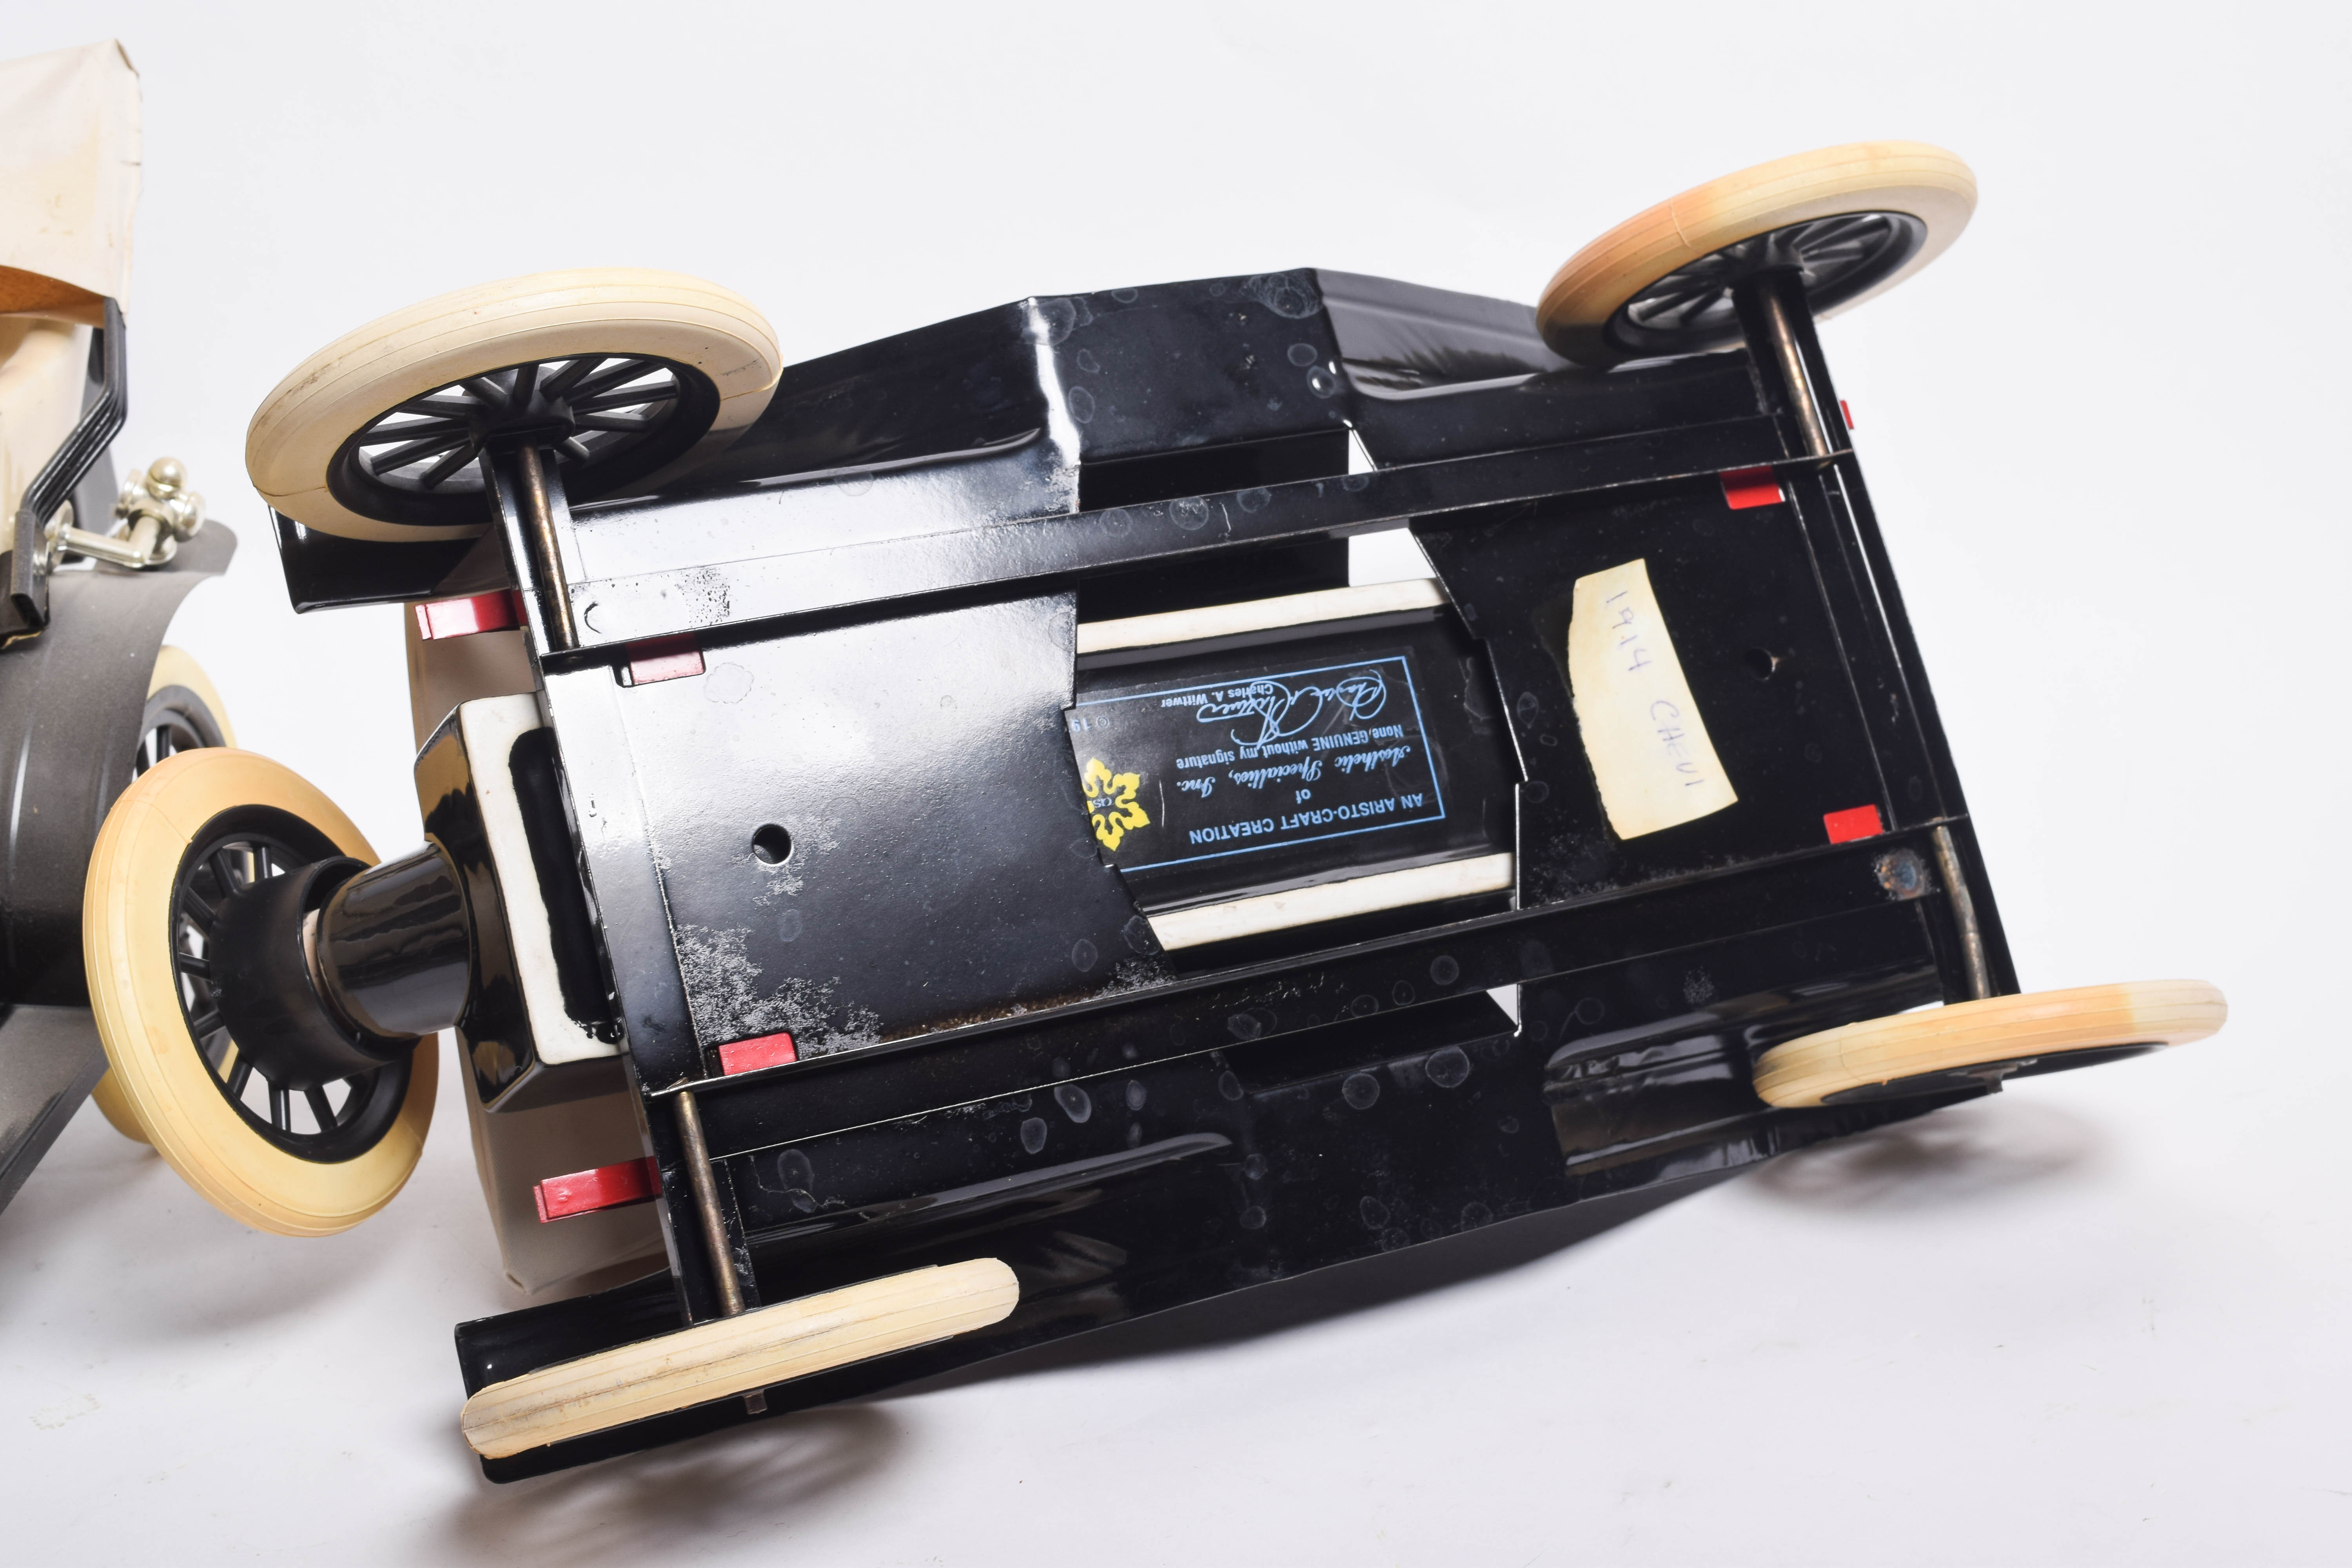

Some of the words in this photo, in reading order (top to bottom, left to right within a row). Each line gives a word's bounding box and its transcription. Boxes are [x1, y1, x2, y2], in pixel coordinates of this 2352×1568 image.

[1606, 591, 1652, 671] 1914
[1211, 691, 1224, 703] A.
[1227, 682, 1274, 698] Charles
[1161, 694, 1207, 709] Wittwer
[1261, 739, 1308, 757] without
[1311, 730, 1368, 751] GENUINE
[1175, 750, 1235, 770] signature
[1239, 745, 1258, 759] my
[1176, 775, 1215, 799] Inc.
[1296, 788, 1311, 804] of
[1401, 793, 1423, 809] AN
[1279, 797, 1396, 829] ARISTO-CRAFT
[1189, 817, 1273, 844] CREATION
